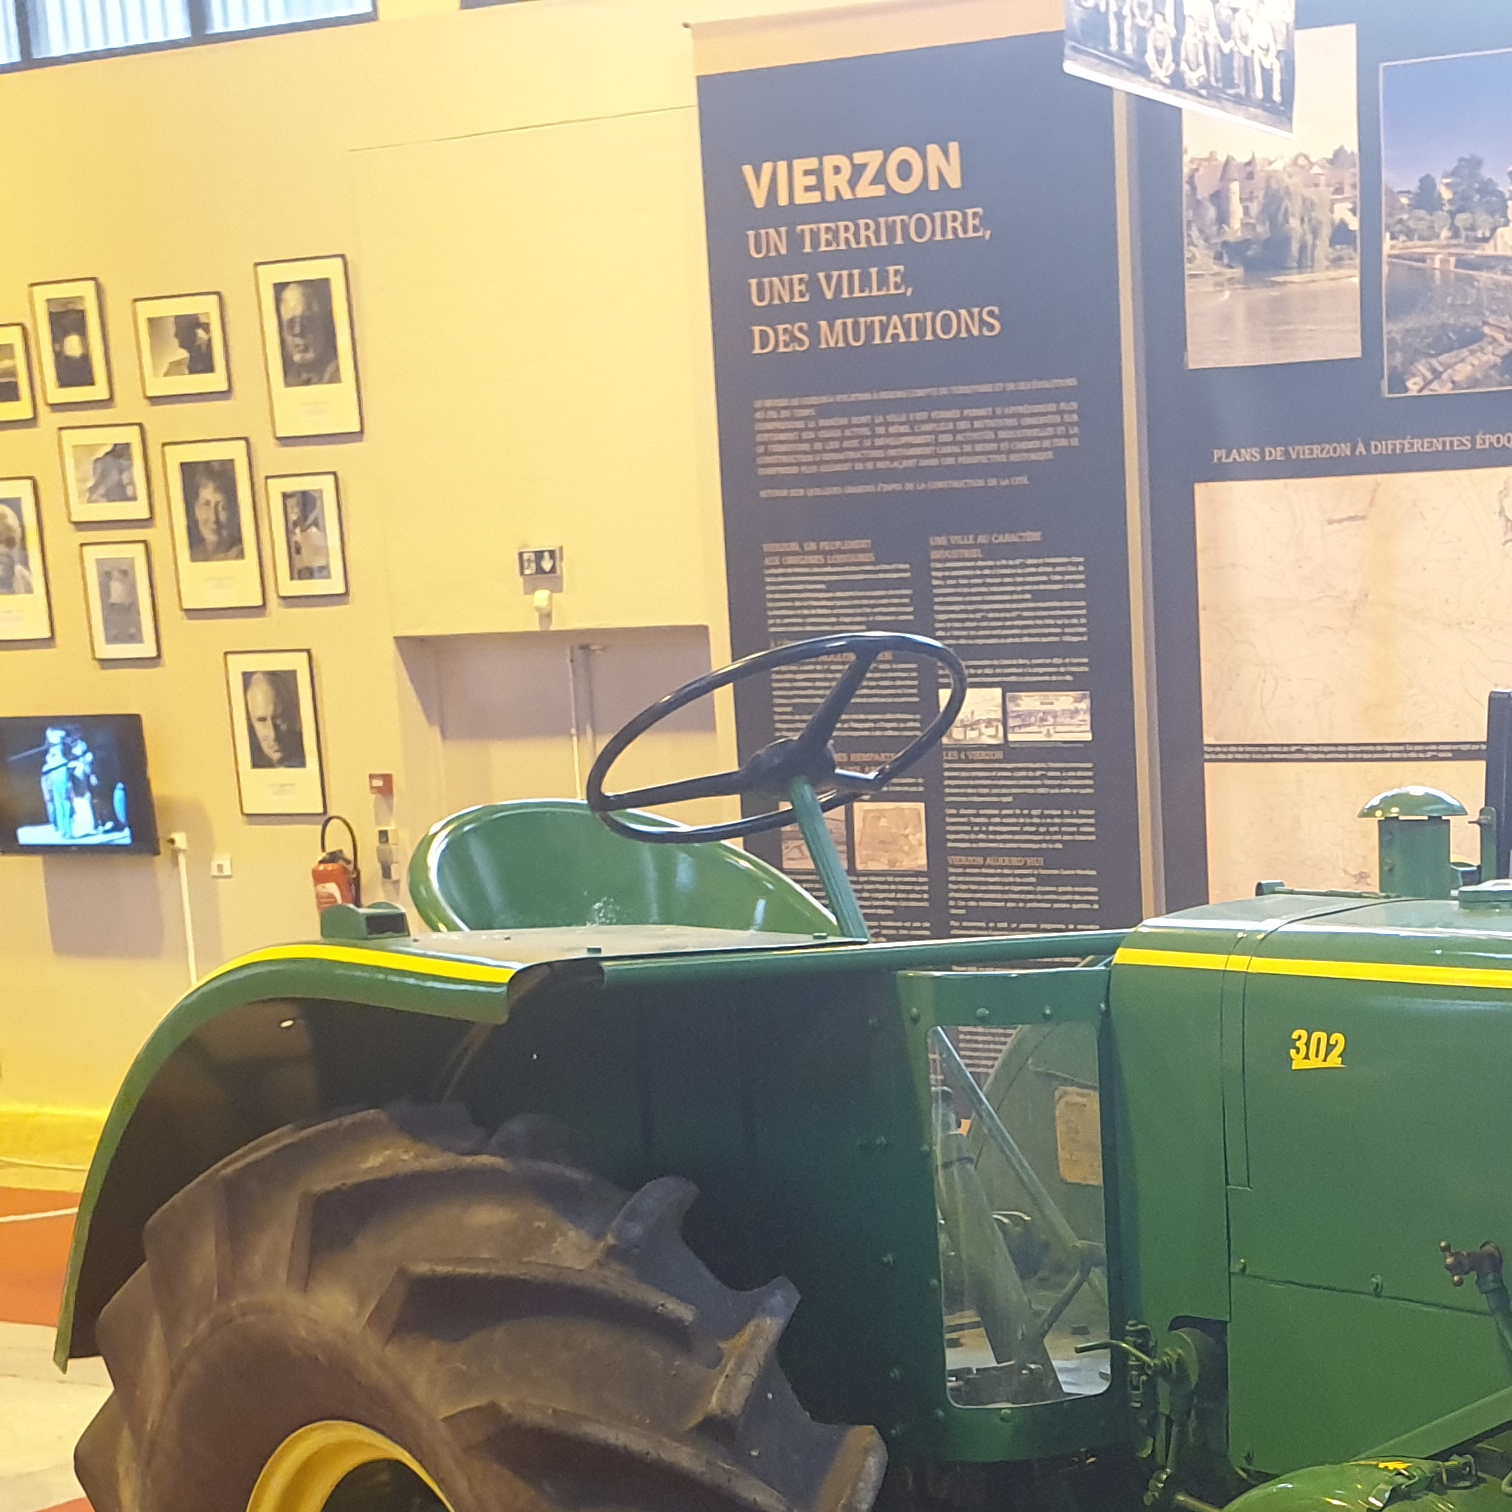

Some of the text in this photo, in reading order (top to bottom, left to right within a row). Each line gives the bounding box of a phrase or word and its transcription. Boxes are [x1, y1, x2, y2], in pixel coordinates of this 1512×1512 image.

[742, 141, 962, 209] VIERZON
[746, 207, 992, 258] UN TERRITOIRE,
[748, 265, 913, 307] UNE VILLE,
[751, 305, 1002, 355] DES MUTATIONS
[1213, 448, 1261, 464] PLANS
[1265, 446, 1285, 461] DE
[1289, 442, 1351, 460] VIERZON
[1355, 438, 1367, 456] À
[1370, 435, 1472, 455] DIFFÉRENTES
[1290, 1029, 1346, 1070] 302
